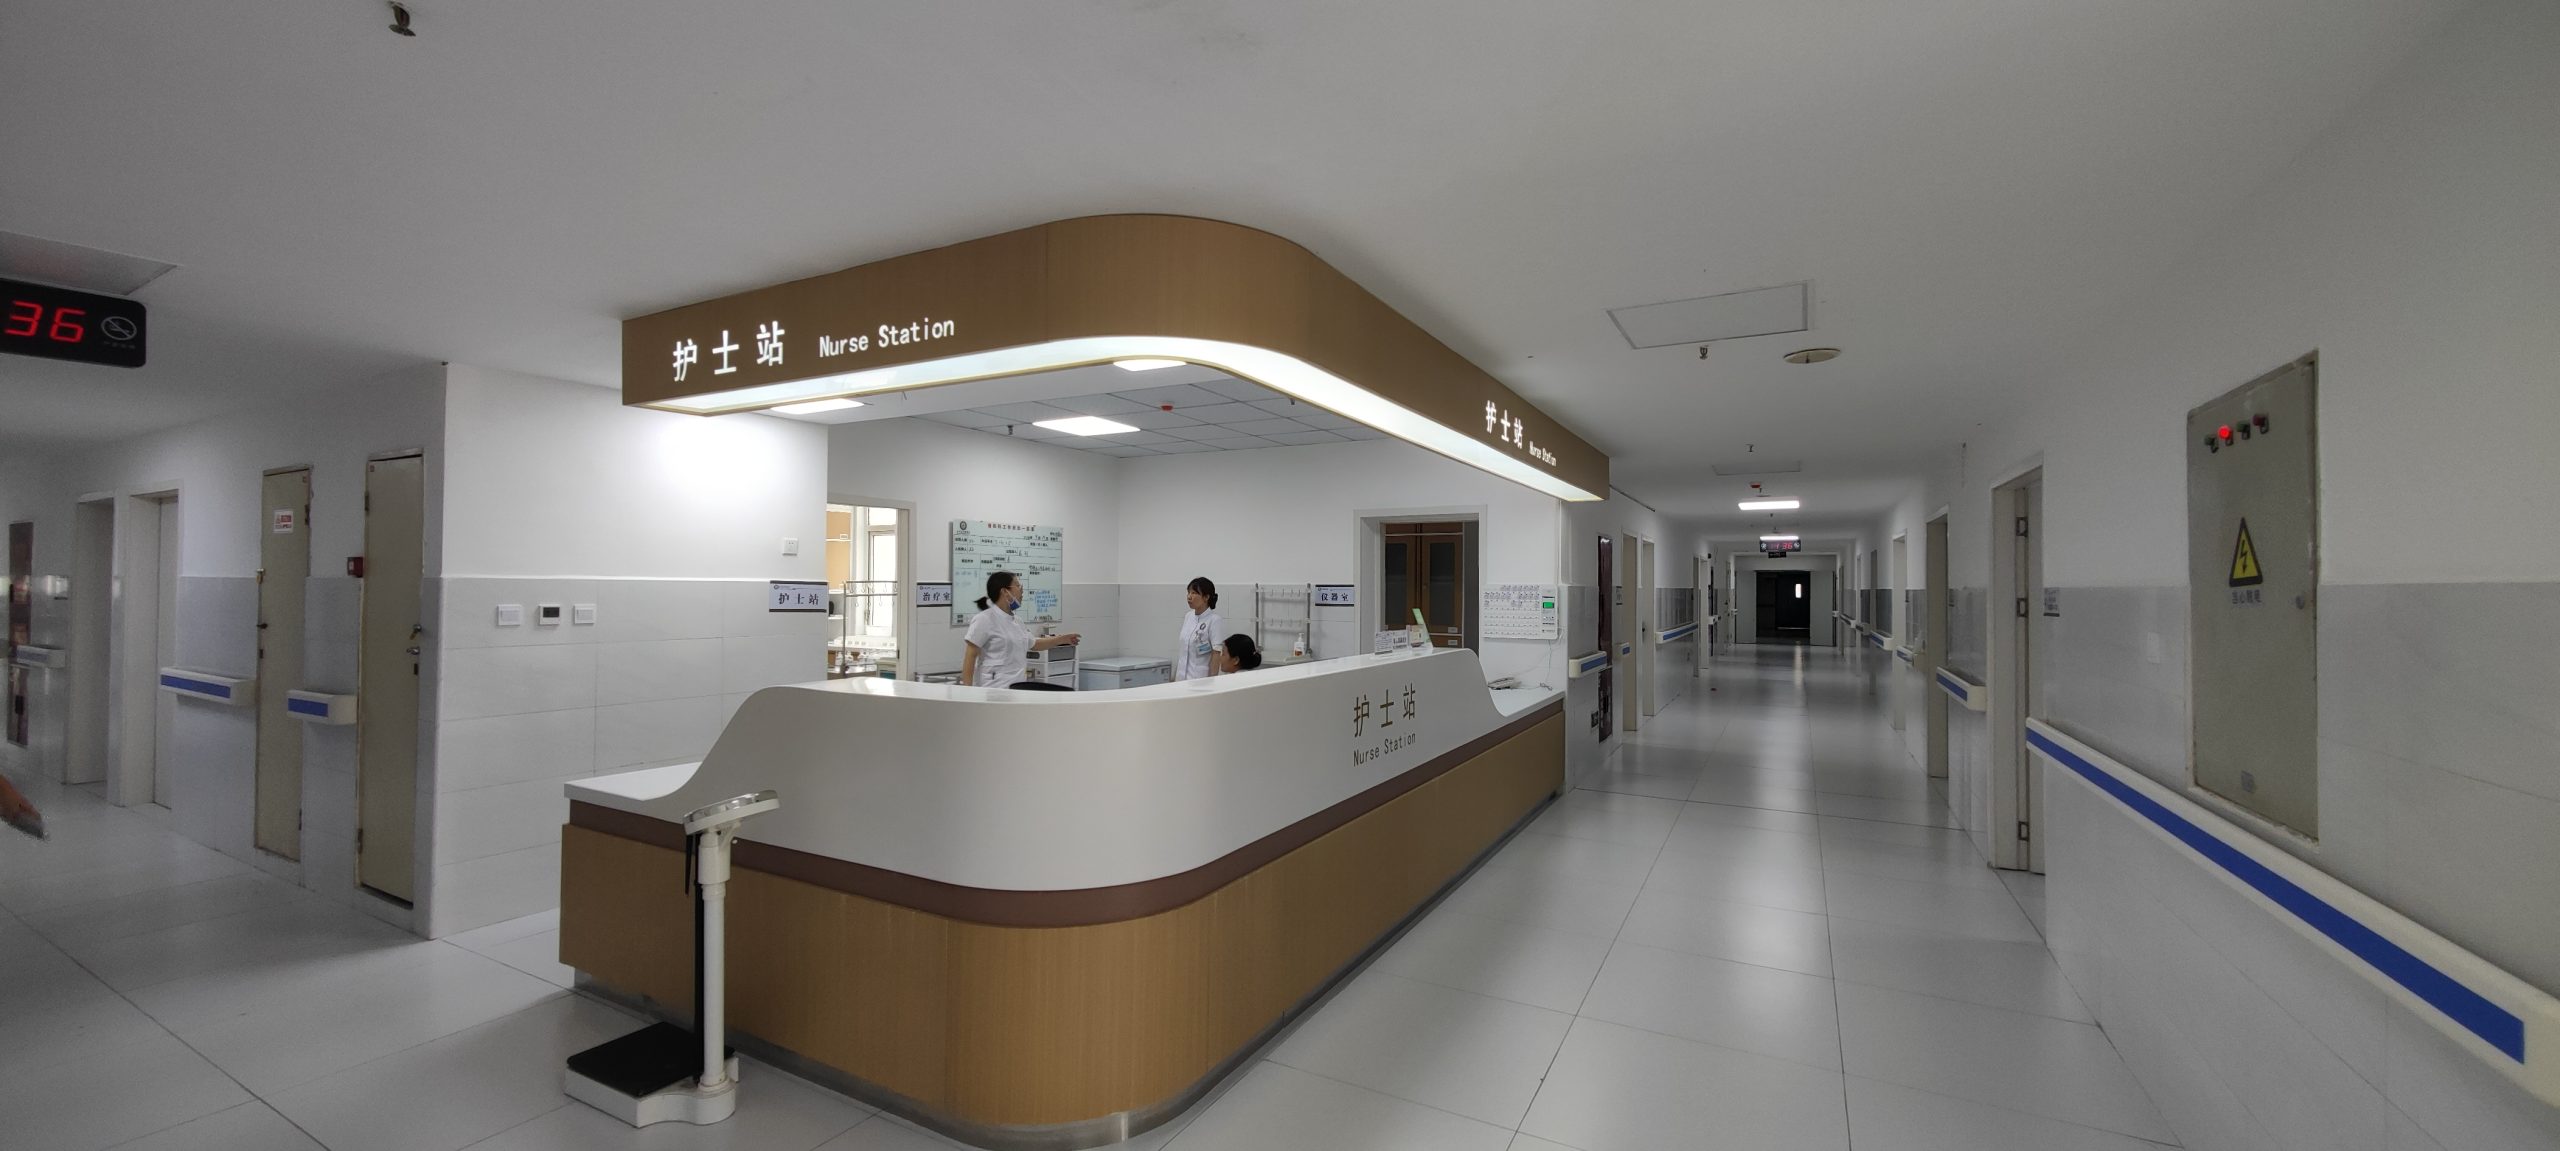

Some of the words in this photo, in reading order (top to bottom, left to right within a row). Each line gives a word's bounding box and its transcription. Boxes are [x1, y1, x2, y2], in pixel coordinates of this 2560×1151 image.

[3, 299, 87, 343] 36
[672, 320, 785, 382] 护士站
[819, 335, 869, 358] Nurse
[878, 317, 955, 348] Station
[1485, 399, 1524, 449] 护士站
[1529, 440, 1542, 459] Nurse
[1541, 447, 1557, 467] Station
[778, 592, 819, 606] 护士站
[922, 591, 951, 601] 治疗室
[1353, 682, 1416, 738] 护士站
[1353, 746, 1380, 767] Nurse
[1384, 732, 1416, 755] Station
